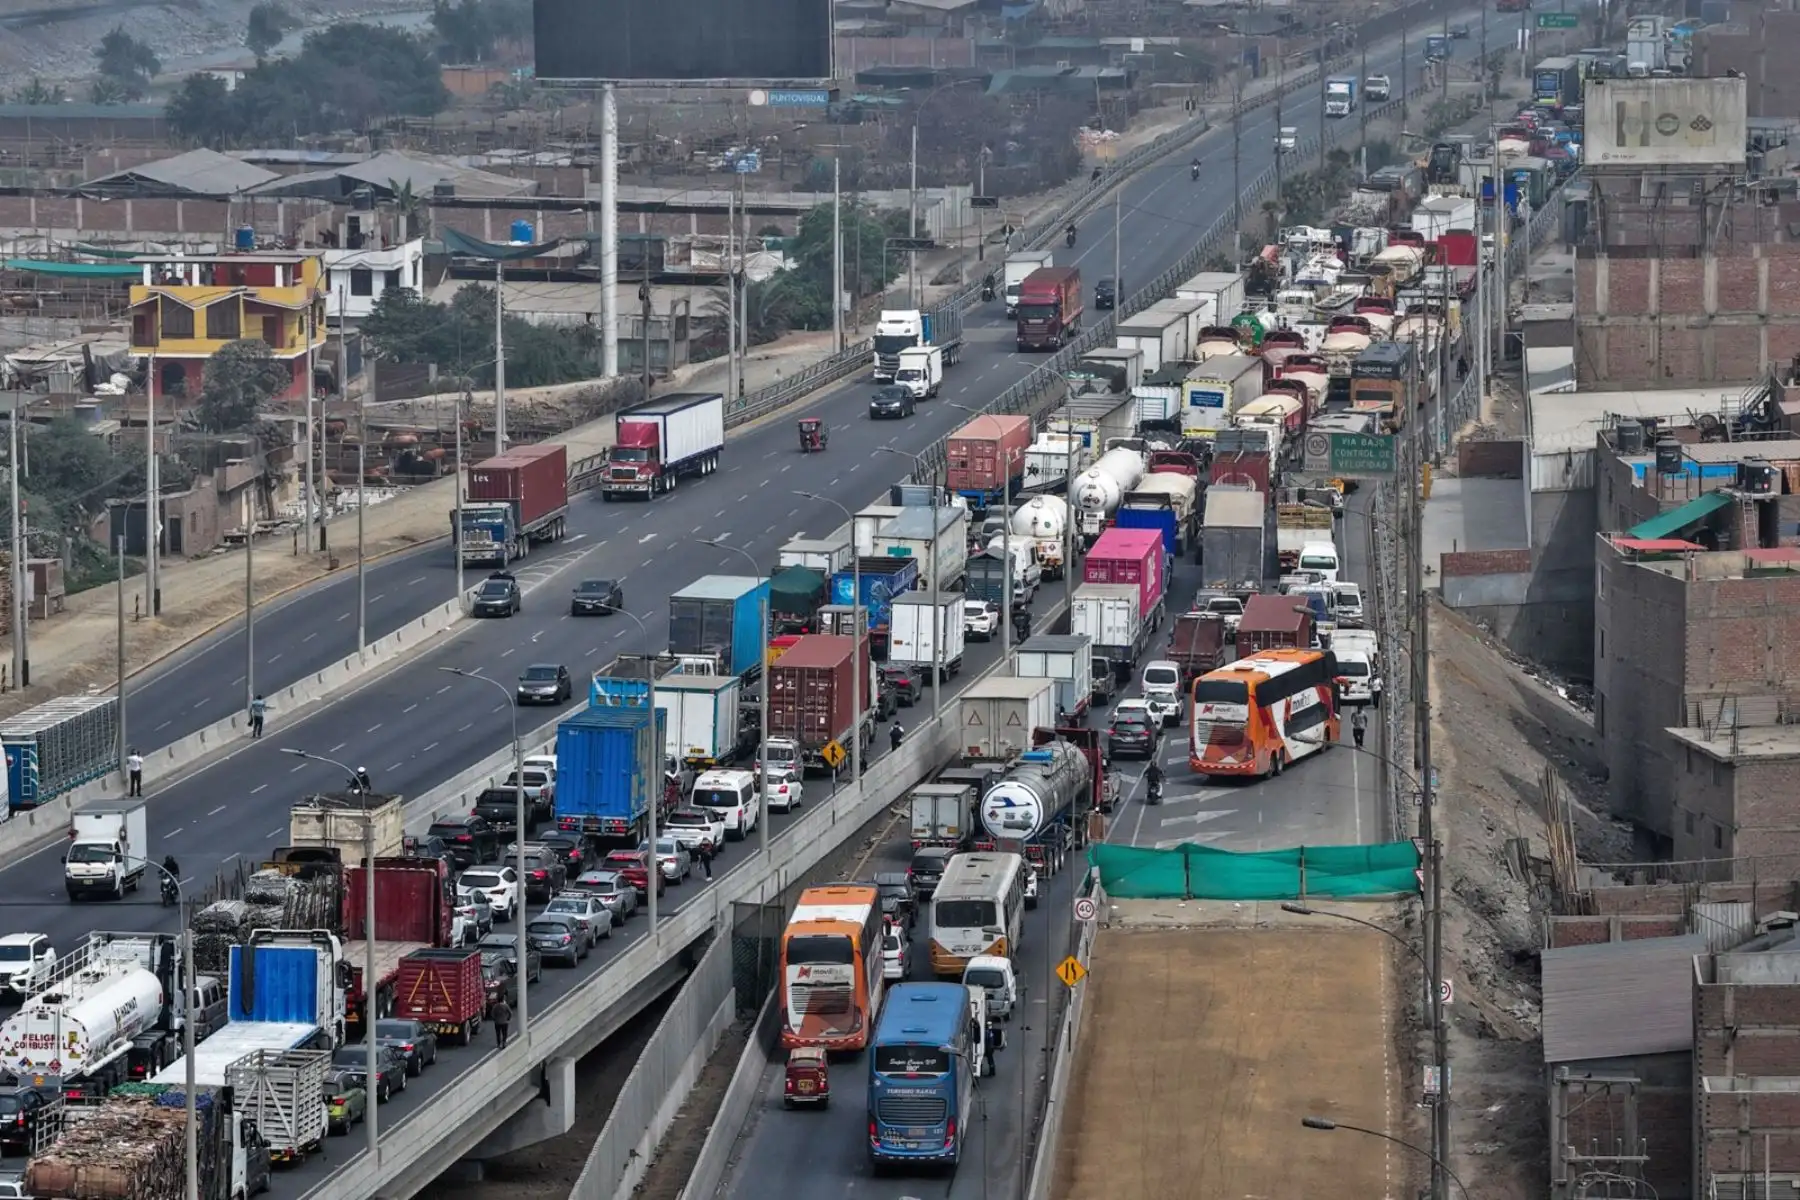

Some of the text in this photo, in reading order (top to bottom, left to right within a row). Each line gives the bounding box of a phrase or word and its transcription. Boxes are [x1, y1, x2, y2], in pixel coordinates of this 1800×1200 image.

[1334, 449, 1391, 459] CONTROL DE
[473, 473, 489, 483] tex
[1080, 905, 1091, 913] 40
